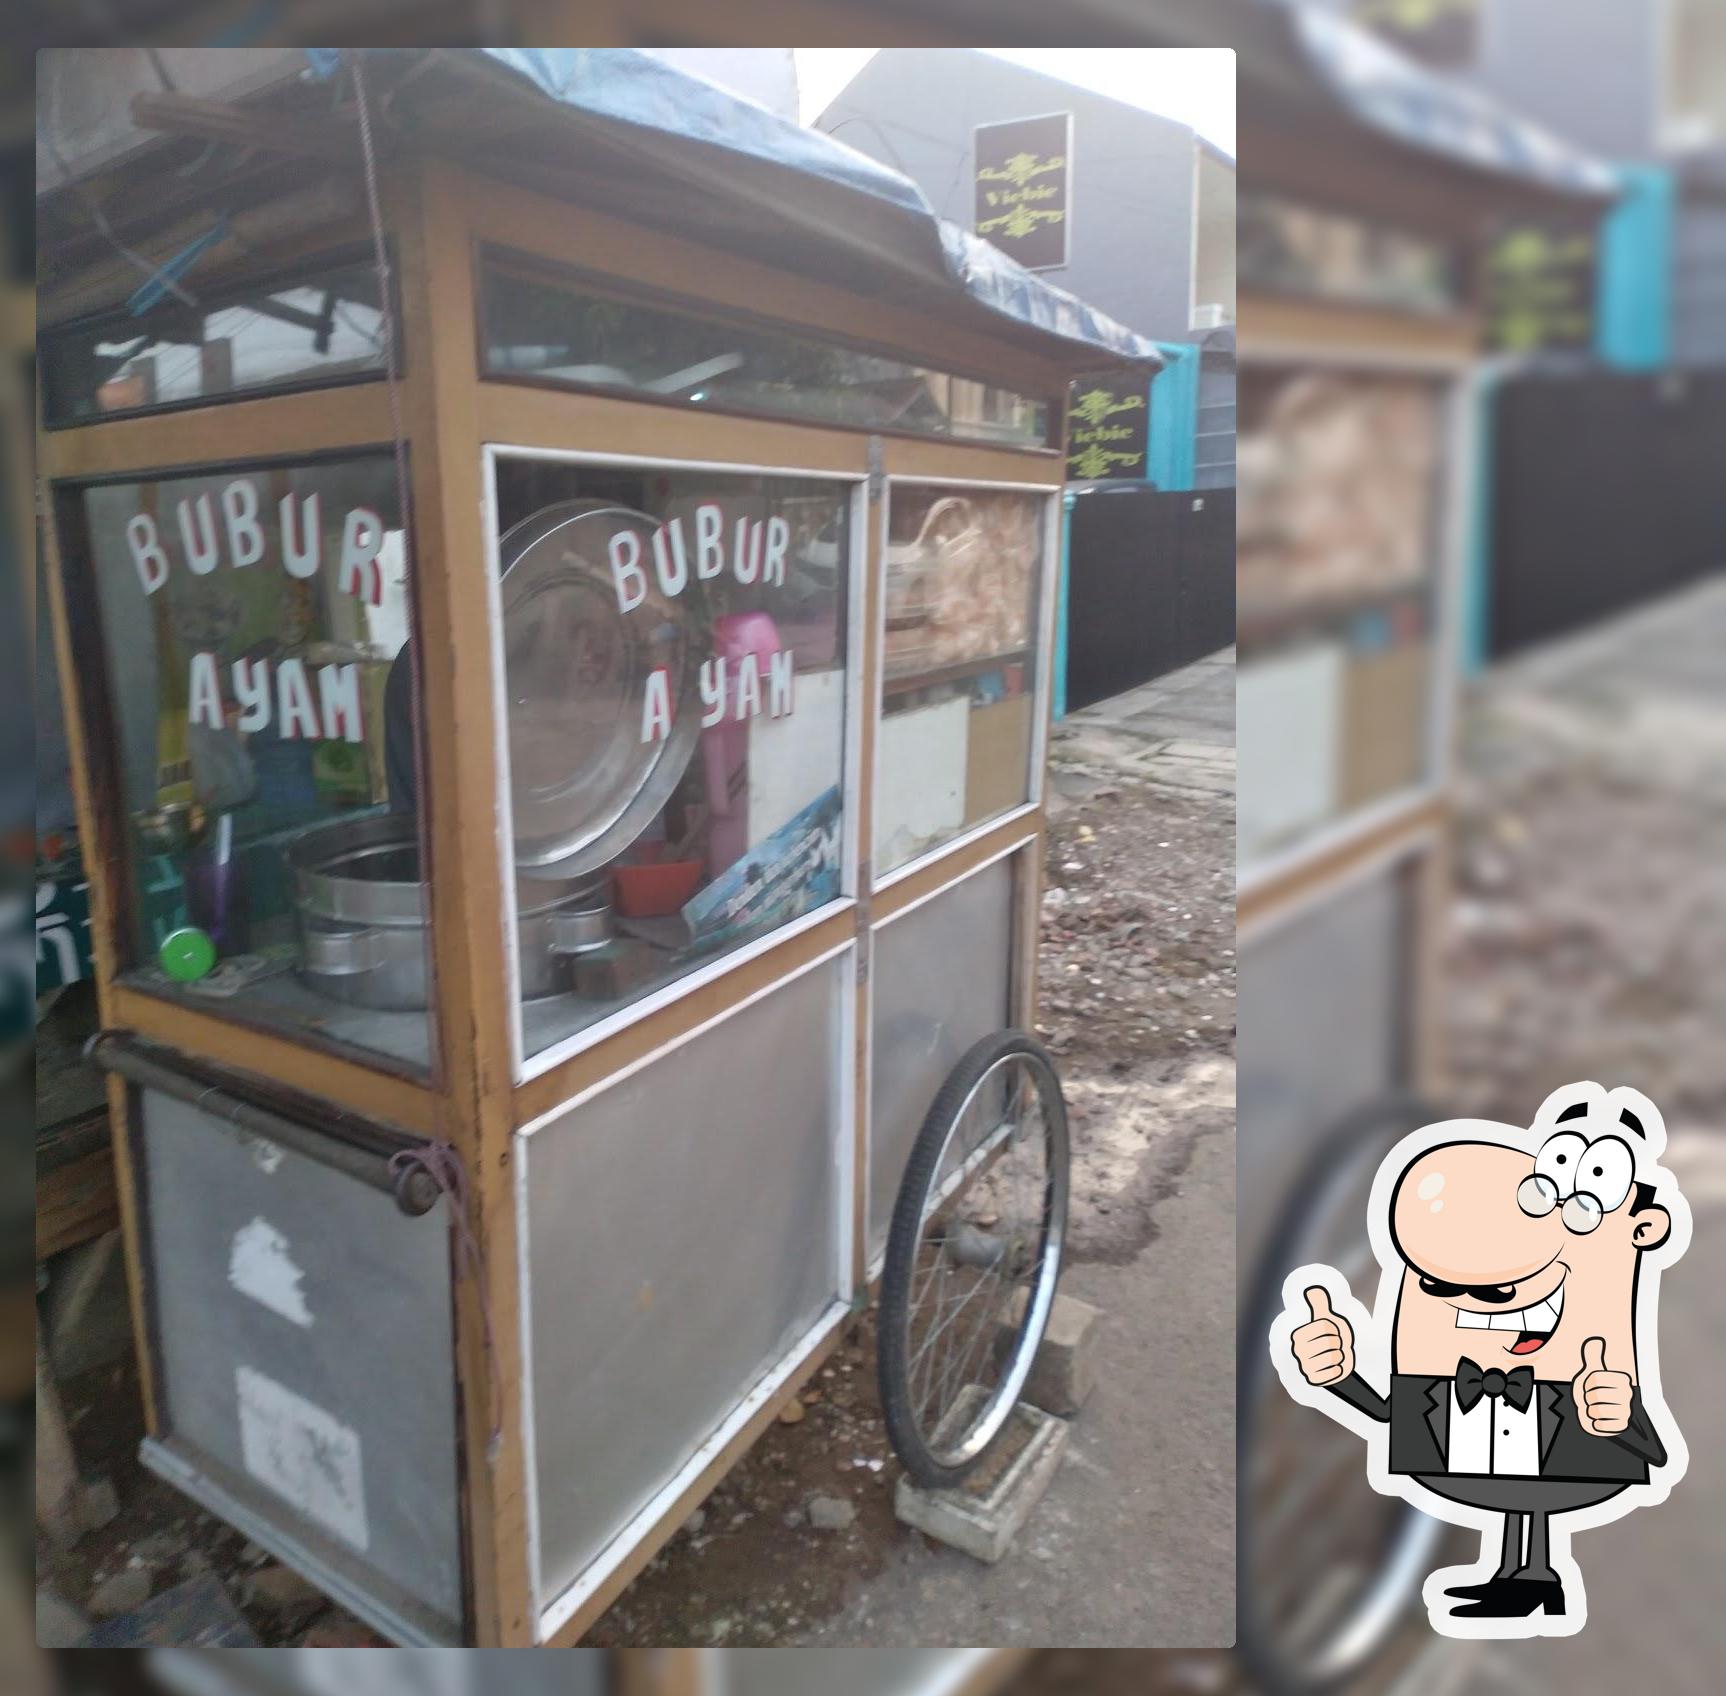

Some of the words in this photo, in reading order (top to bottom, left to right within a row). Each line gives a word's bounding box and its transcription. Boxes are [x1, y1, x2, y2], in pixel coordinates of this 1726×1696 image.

[126, 479, 383, 607] BUBUR
[608, 501, 790, 614] BUBUR
[189, 652, 366, 743] AYAM
